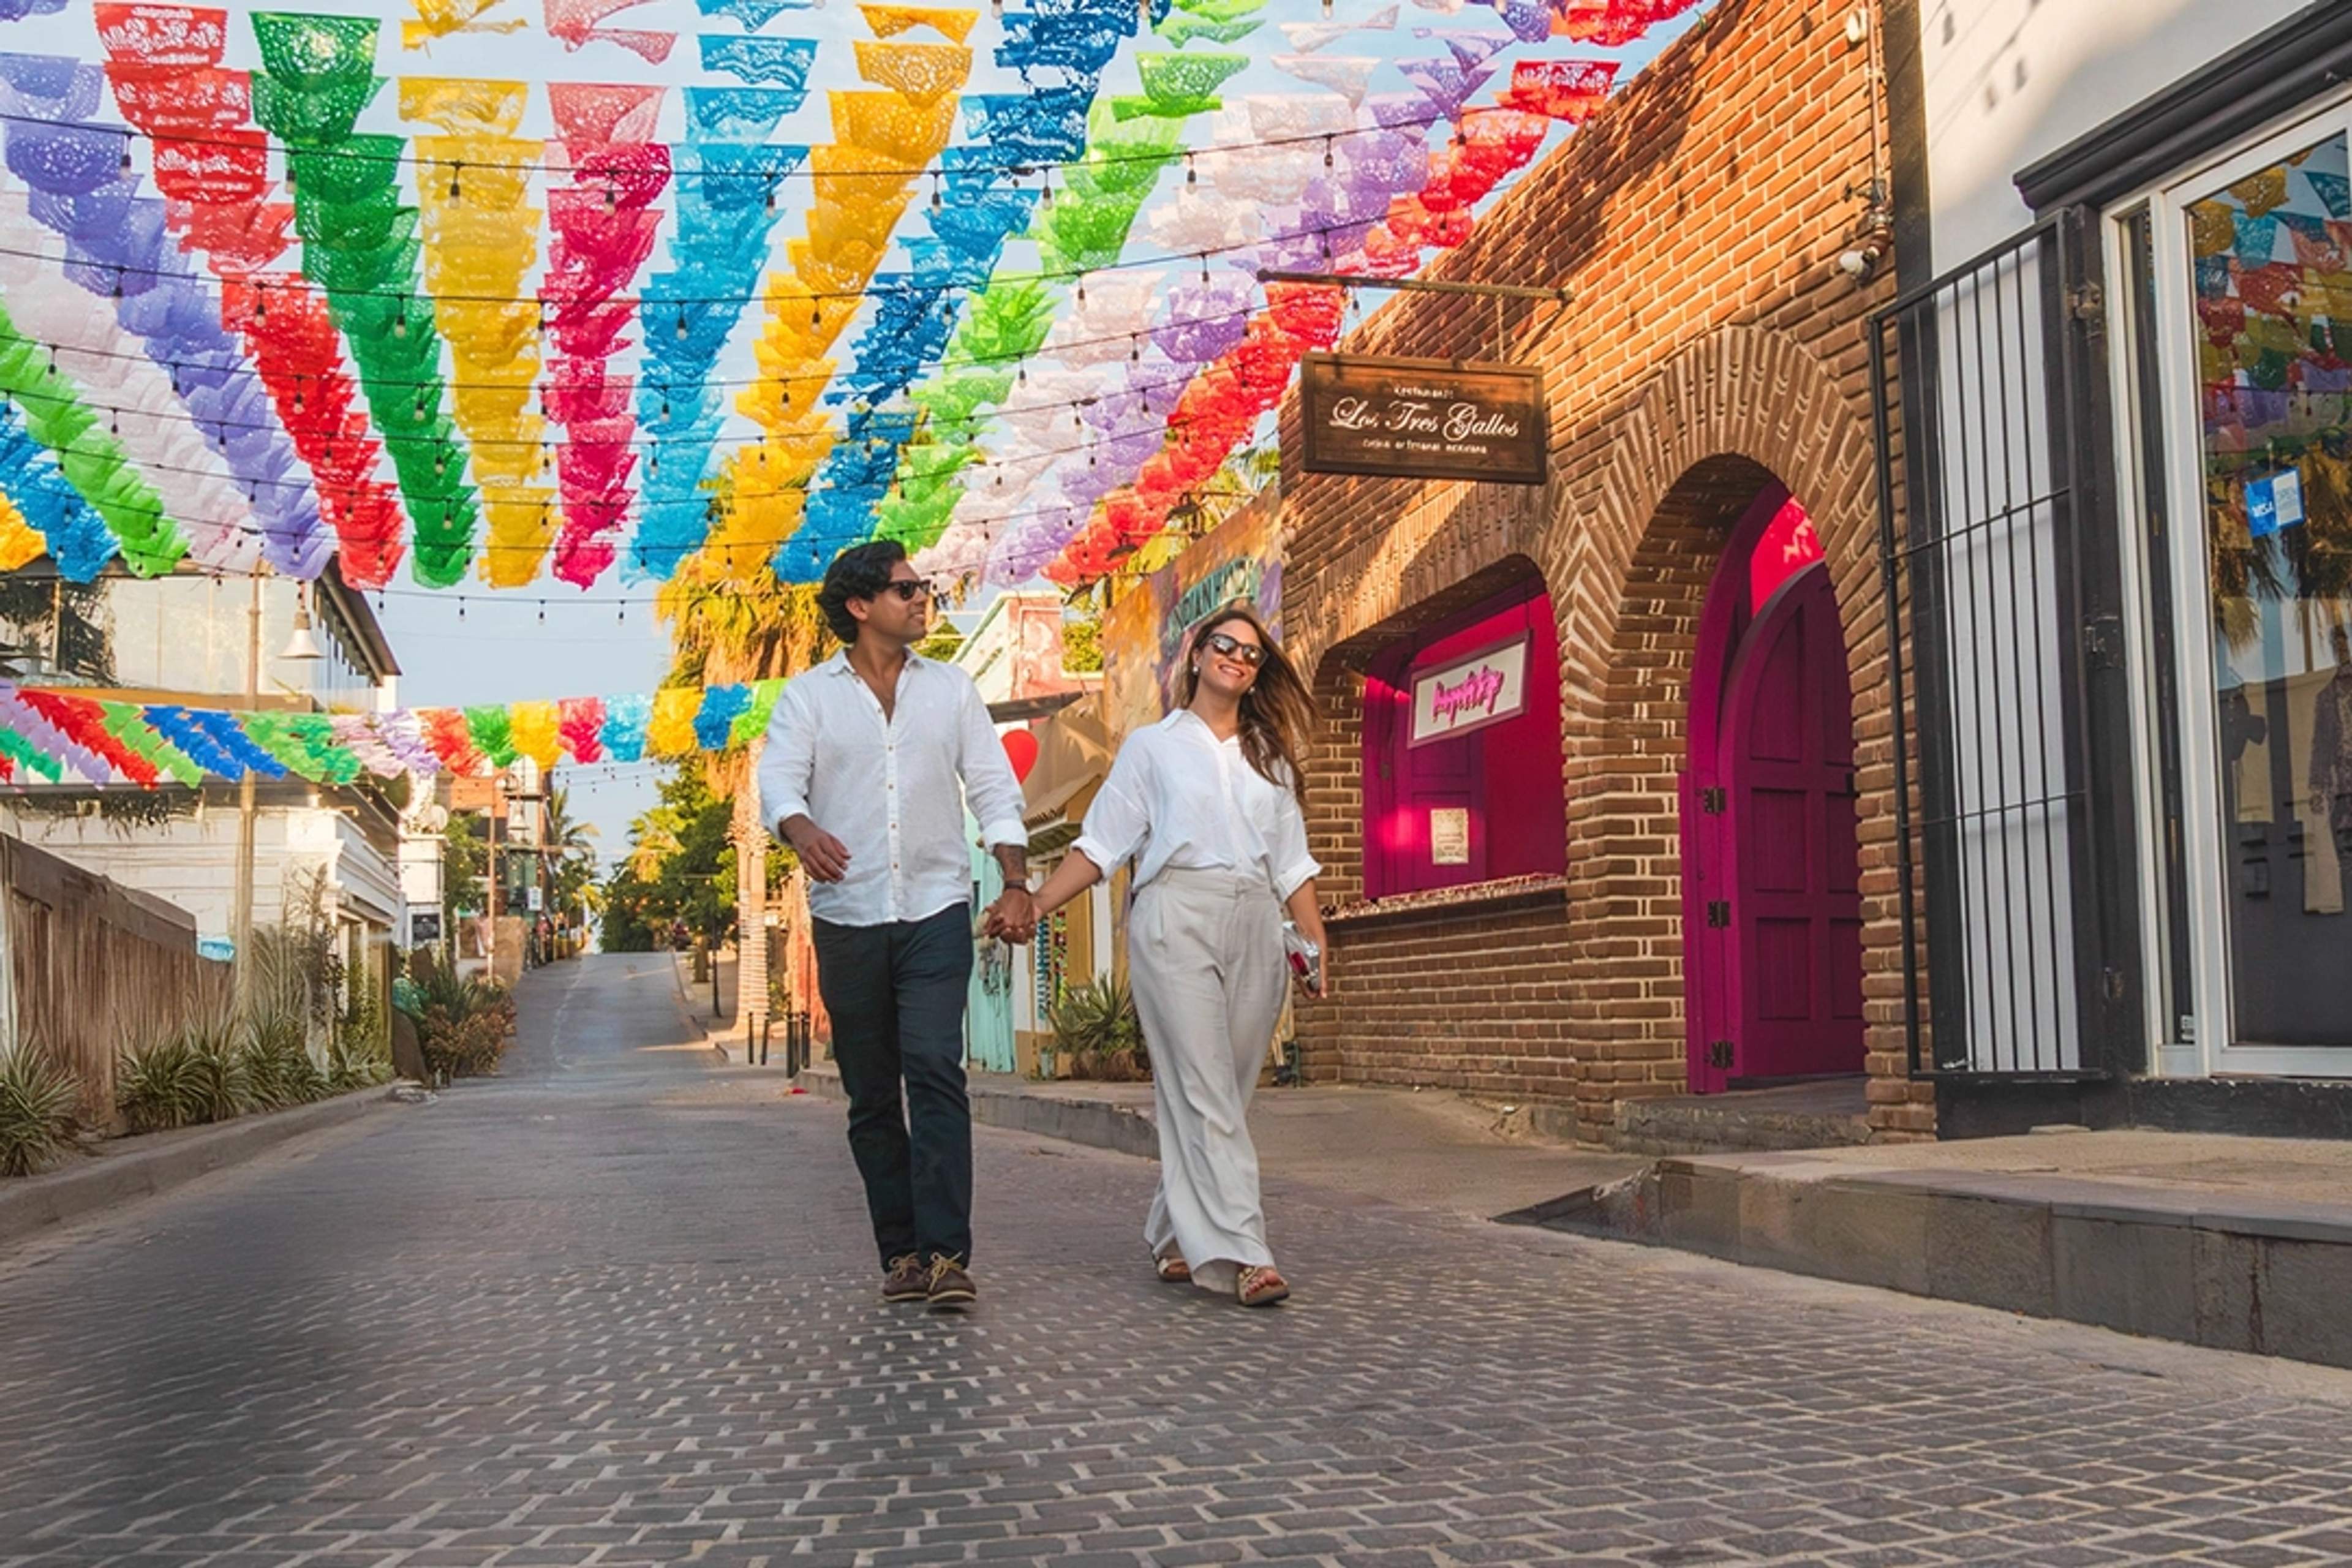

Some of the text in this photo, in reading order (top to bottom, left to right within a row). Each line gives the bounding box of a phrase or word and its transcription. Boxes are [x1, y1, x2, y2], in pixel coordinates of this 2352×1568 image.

[1329, 396, 1520, 441] Los Tres Gallos
